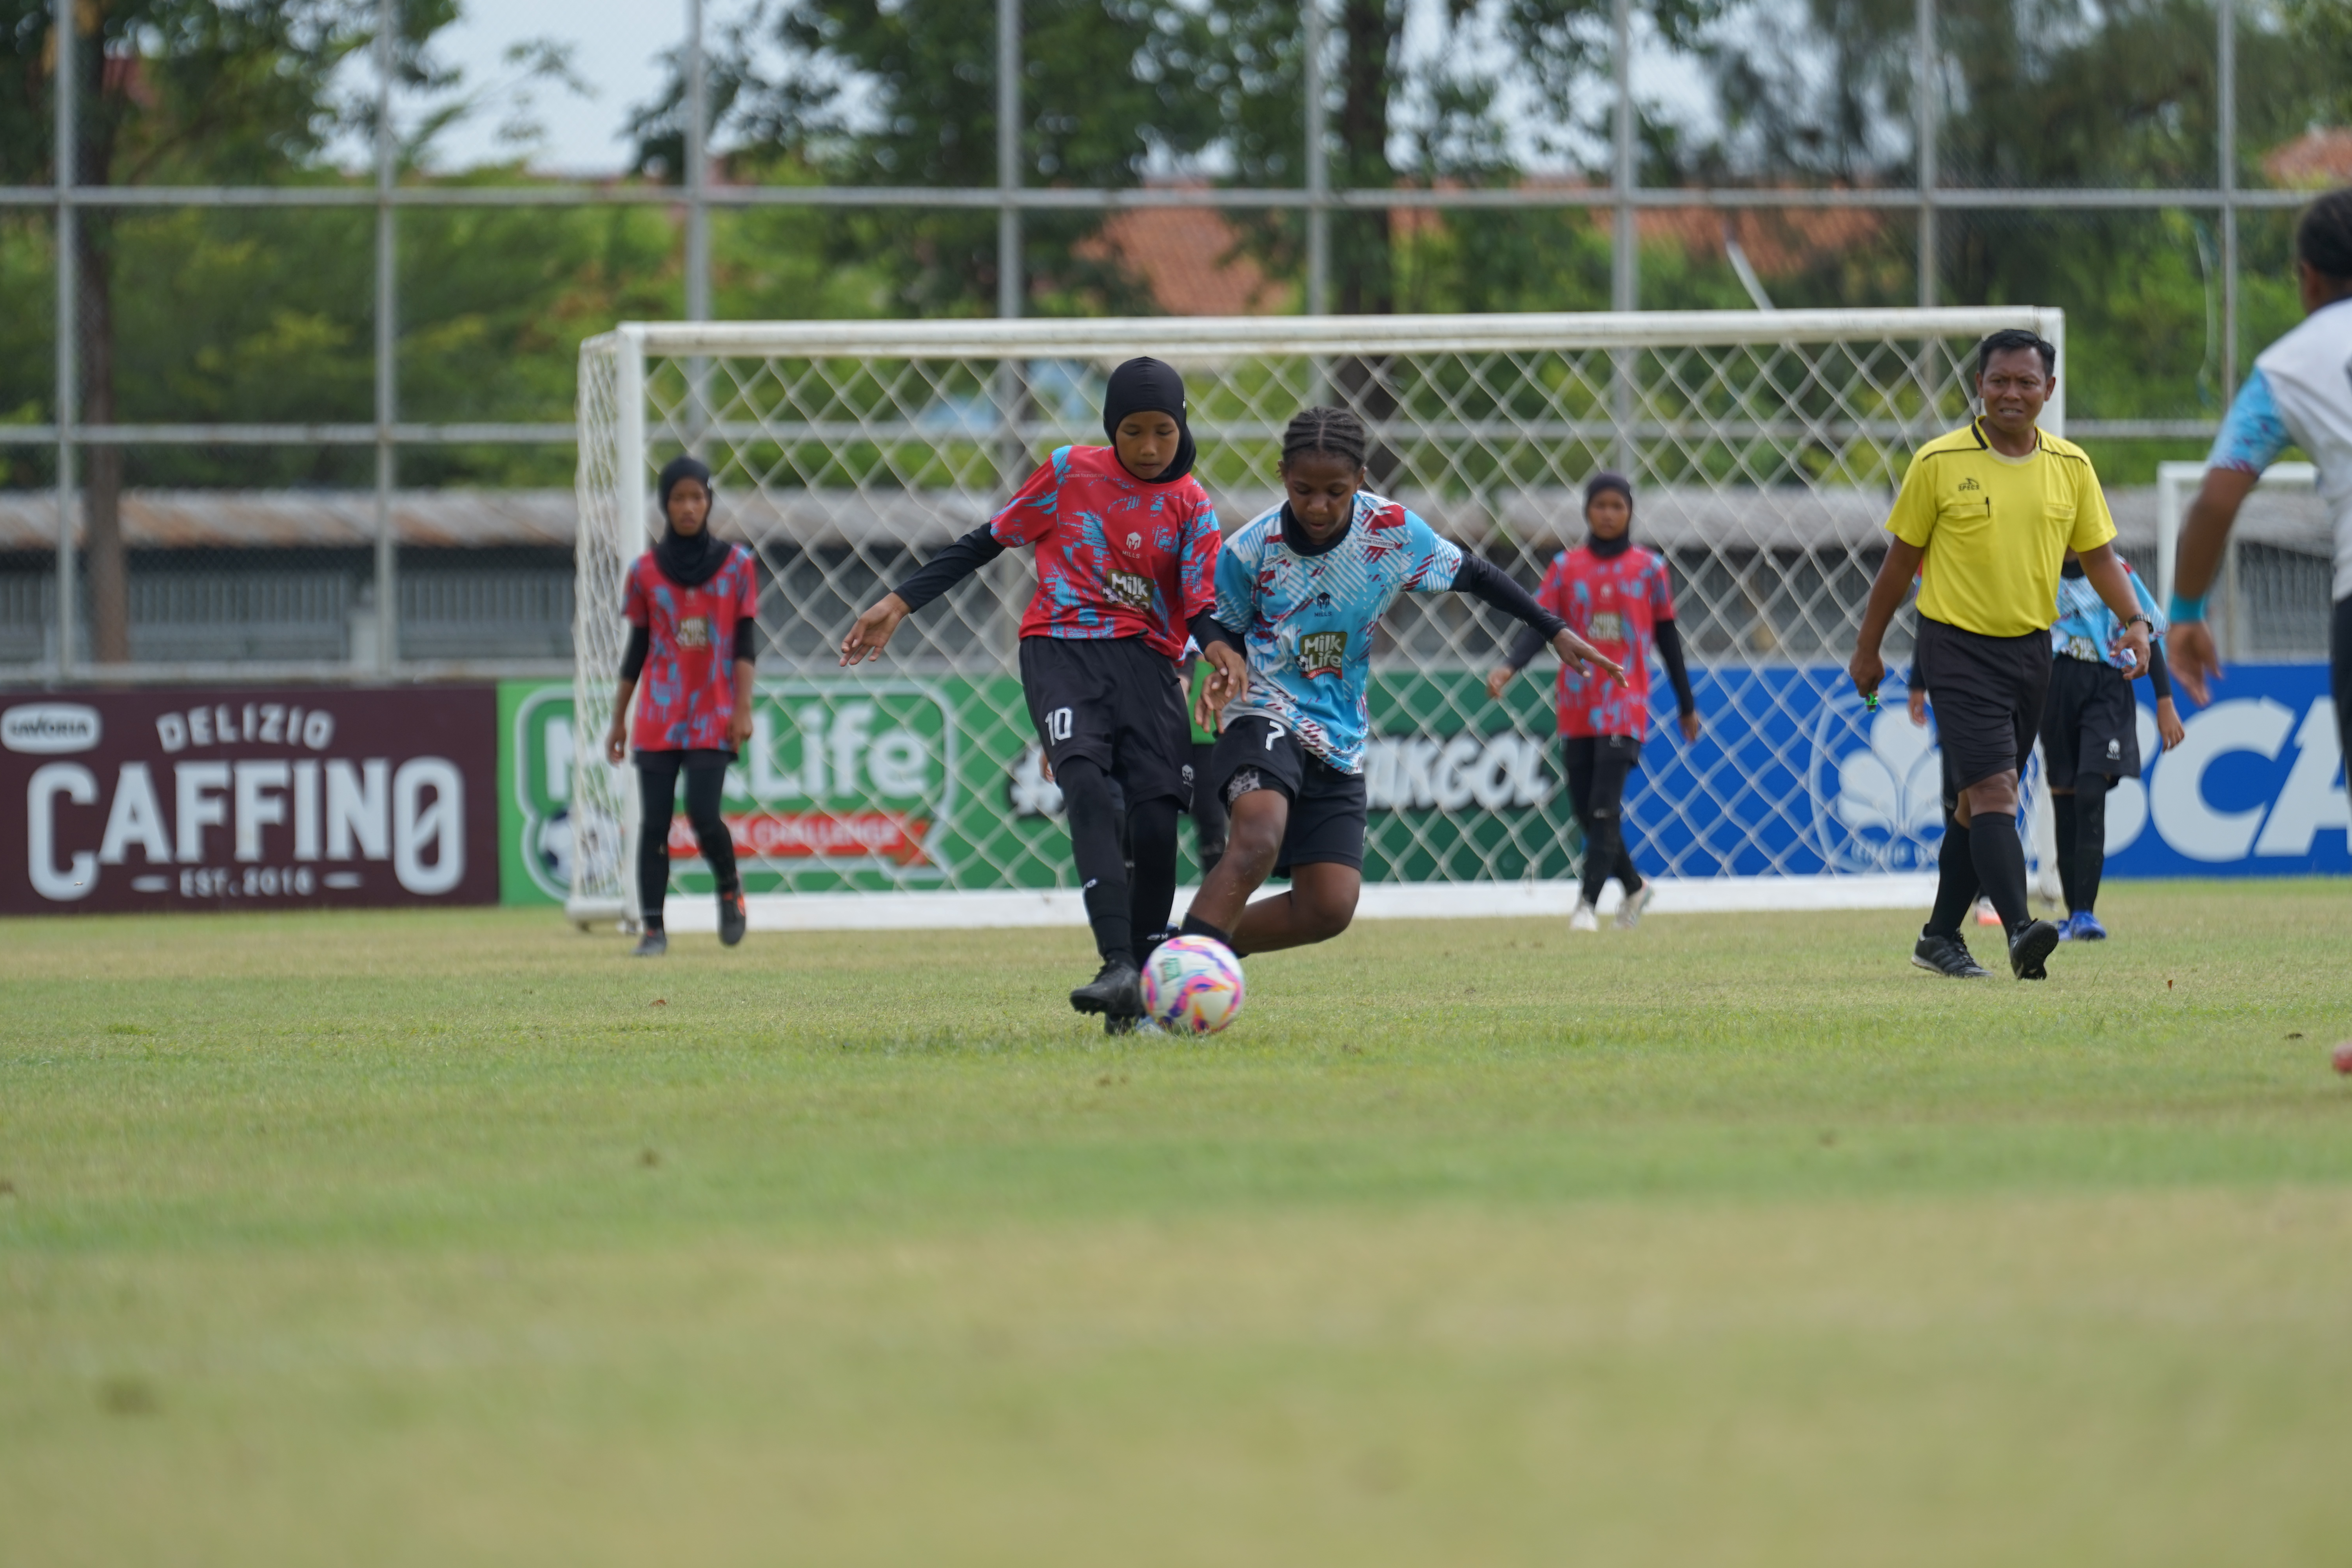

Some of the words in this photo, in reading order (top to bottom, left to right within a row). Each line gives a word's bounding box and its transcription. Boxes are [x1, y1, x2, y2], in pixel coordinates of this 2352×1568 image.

[1122, 550, 1140, 559] MILLS
[1111, 573, 1148, 597] Milk
[1304, 635, 1342, 655] Milk
[1308, 650, 1341, 671] Life
[157, 703, 336, 753] DELIZIO
[1044, 707, 1073, 746] 10
[1265, 720, 1286, 751] 7
[27, 756, 467, 901] CAFFINO
